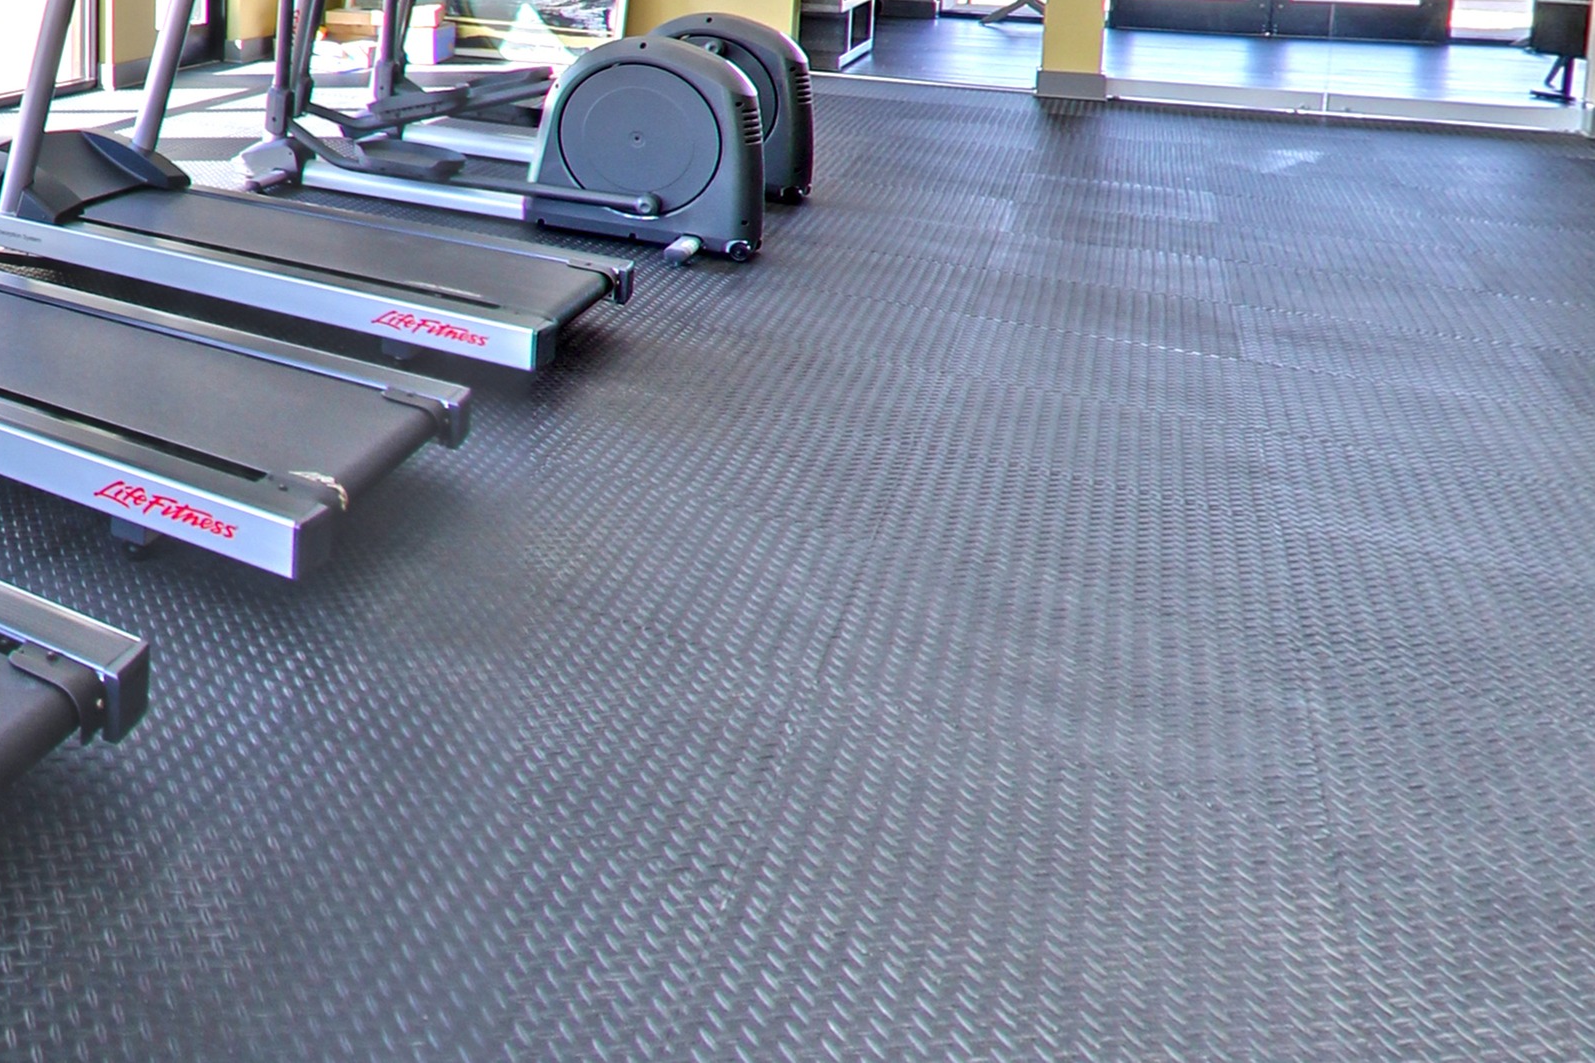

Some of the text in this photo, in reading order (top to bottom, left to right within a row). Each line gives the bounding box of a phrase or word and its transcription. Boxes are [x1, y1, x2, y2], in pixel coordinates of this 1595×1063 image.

[371, 310, 488, 346] Life Fitness
[94, 481, 238, 539] Life Fitness
